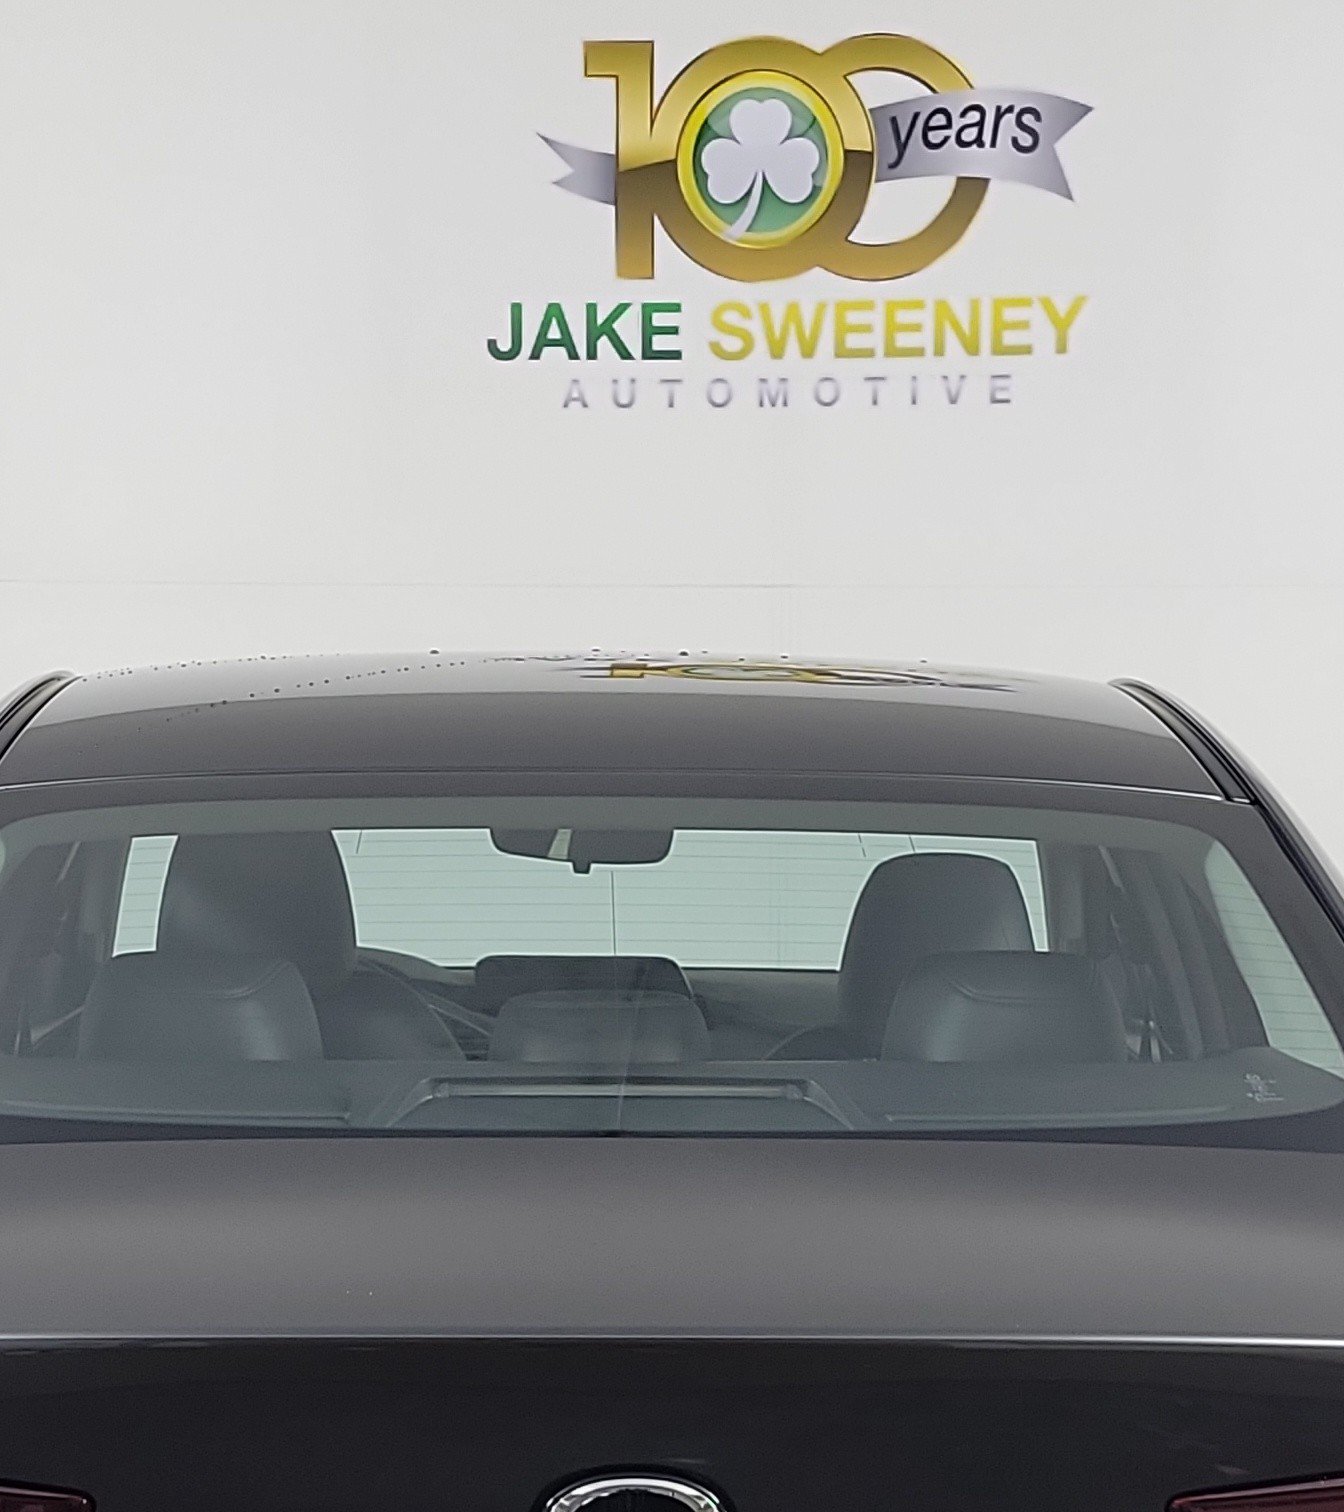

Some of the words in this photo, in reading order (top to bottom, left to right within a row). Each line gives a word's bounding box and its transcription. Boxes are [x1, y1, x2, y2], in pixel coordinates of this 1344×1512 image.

[583, 33, 991, 283] 100
[887, 102, 1043, 170] years
[486, 301, 683, 362] JAKE
[707, 296, 1090, 361] SWEENEY
[562, 374, 1013, 409] AUTOMOTIVE
